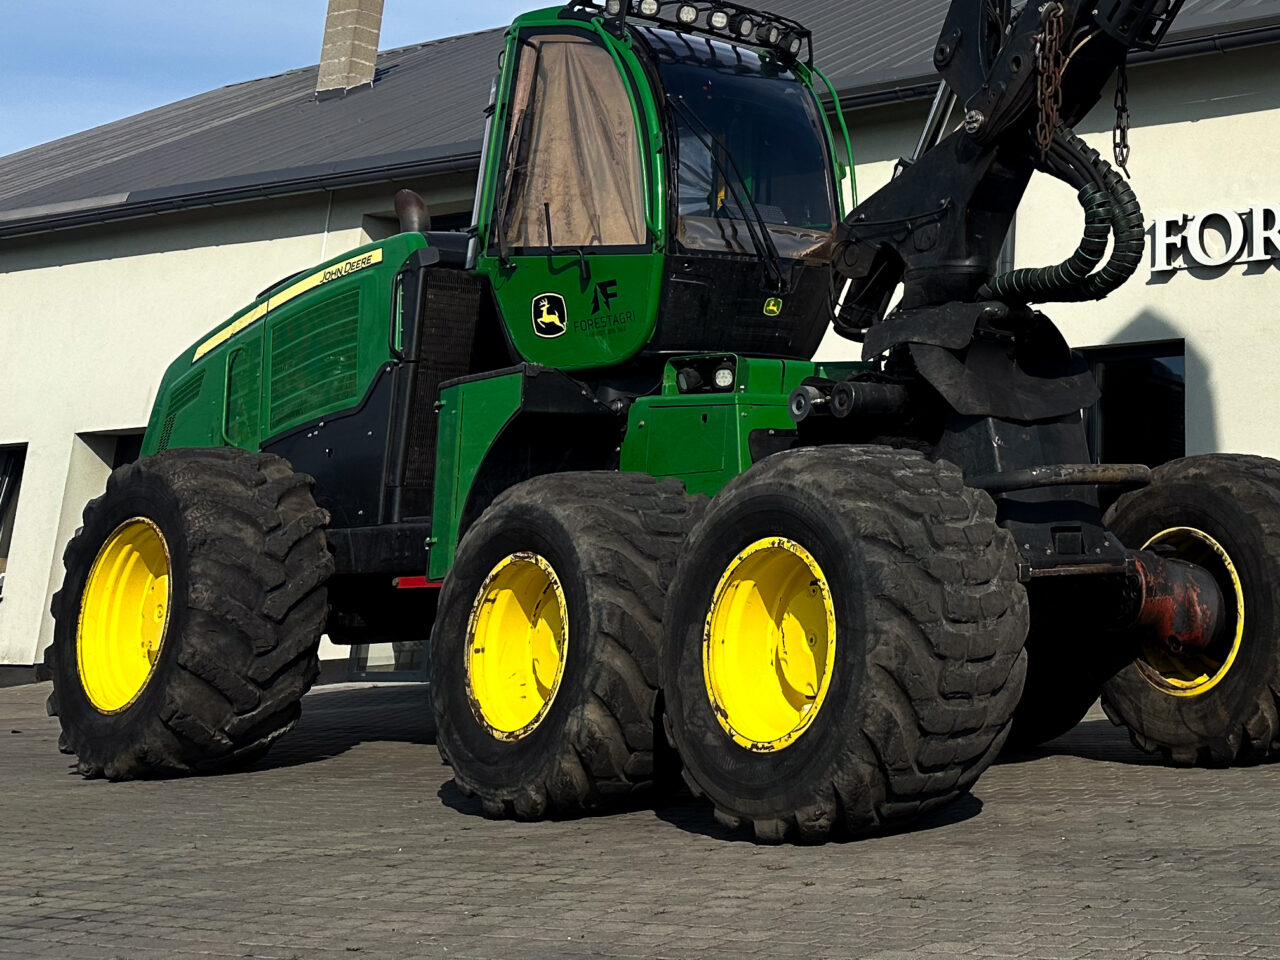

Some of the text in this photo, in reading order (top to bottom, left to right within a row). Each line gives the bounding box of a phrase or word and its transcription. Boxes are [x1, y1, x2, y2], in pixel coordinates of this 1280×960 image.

[319, 254, 373, 283] JOHN DEERE
[573, 311, 636, 333] FORESTAGRI
